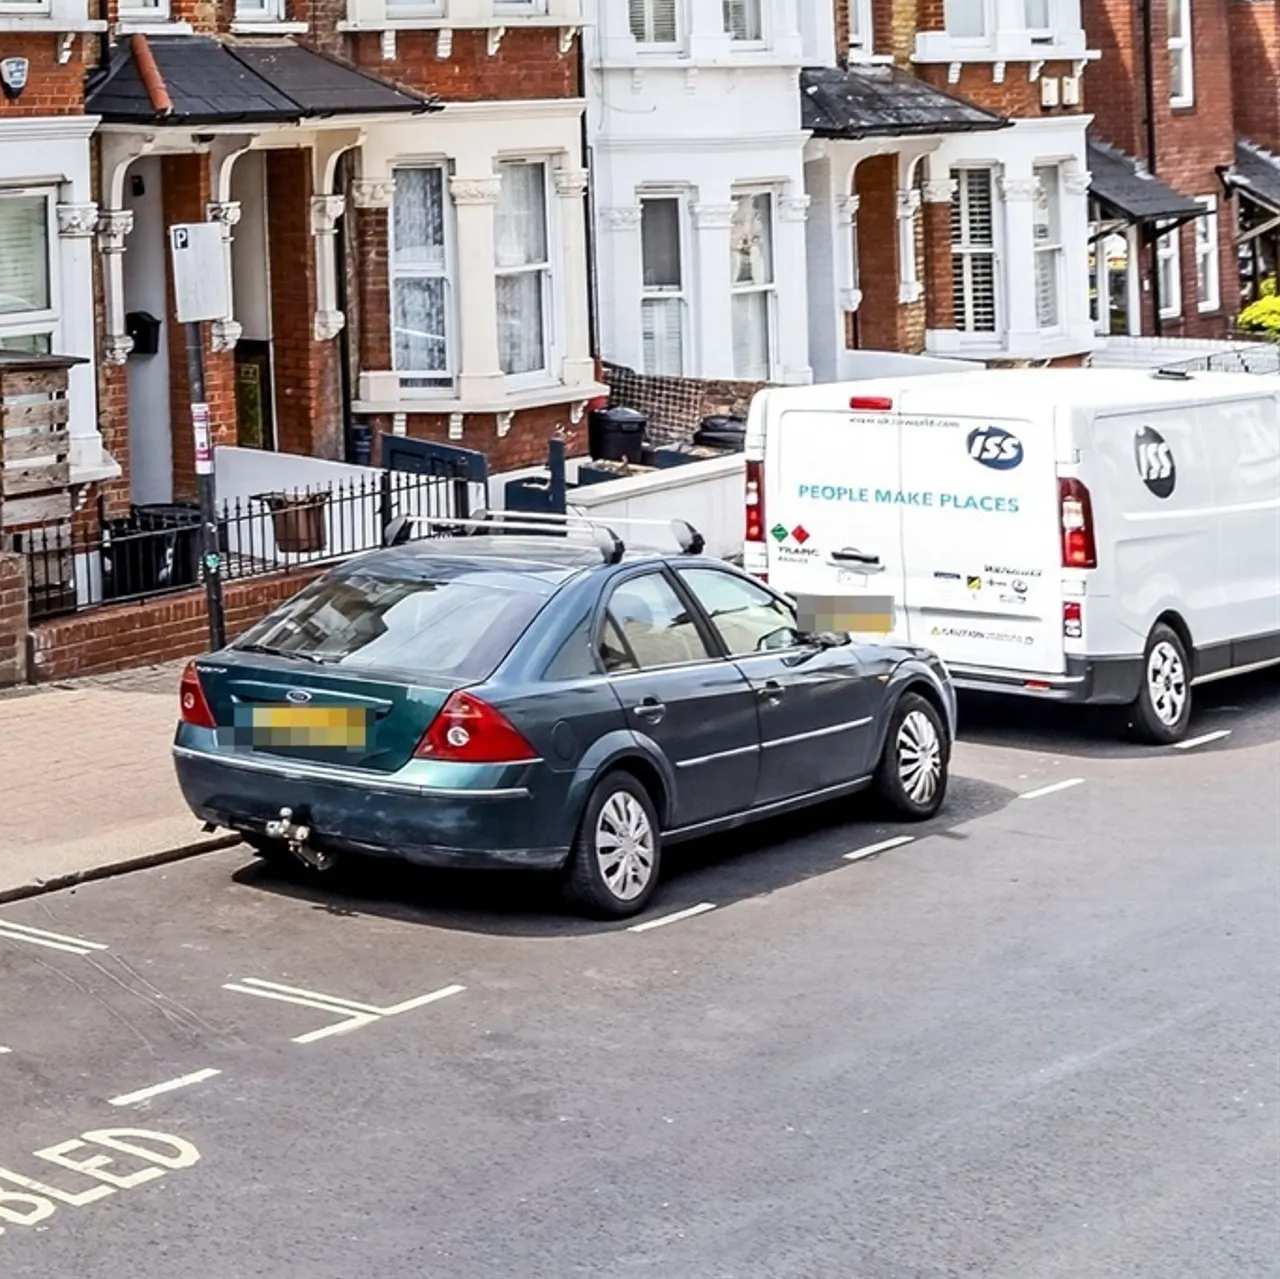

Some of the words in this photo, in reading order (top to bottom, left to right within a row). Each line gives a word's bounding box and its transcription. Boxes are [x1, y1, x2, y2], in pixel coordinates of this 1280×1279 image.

[175, 229, 187, 249] P
[798, 484, 869, 502] PEOPLE
[874, 489, 934, 507] MAKE
[940, 493, 1020, 513] PLACES
